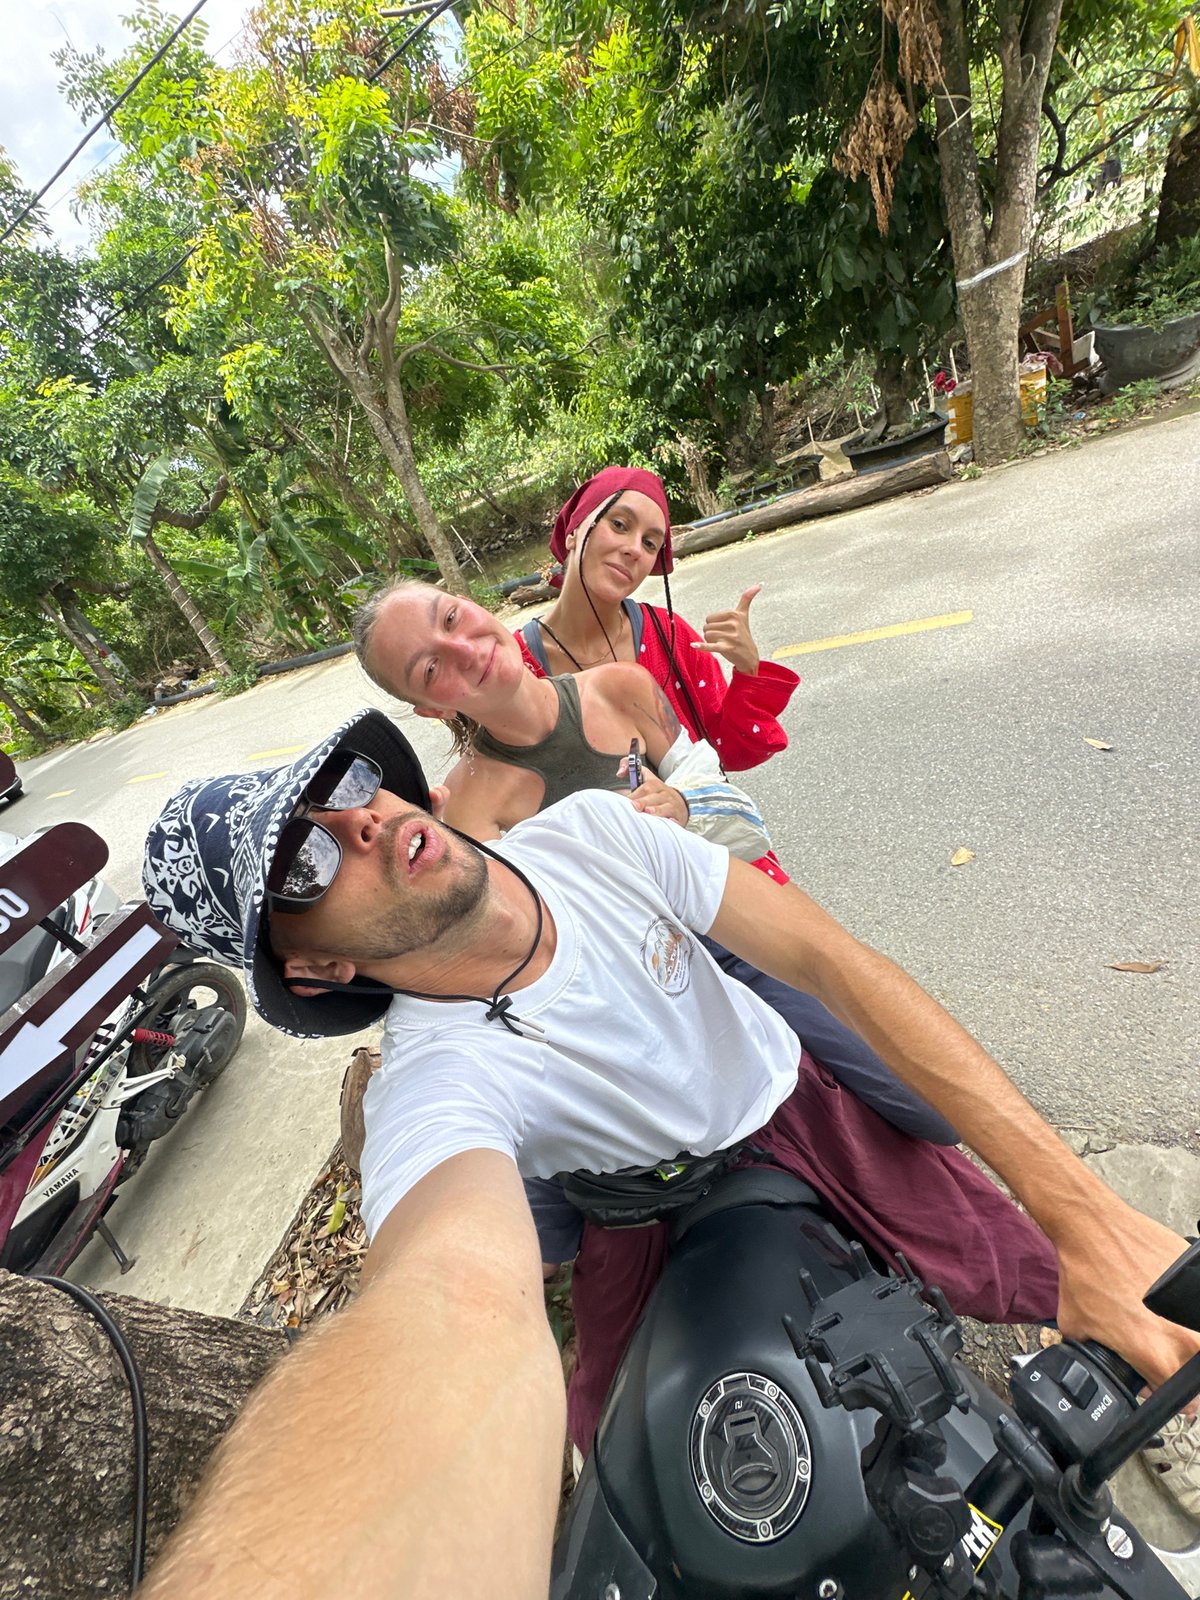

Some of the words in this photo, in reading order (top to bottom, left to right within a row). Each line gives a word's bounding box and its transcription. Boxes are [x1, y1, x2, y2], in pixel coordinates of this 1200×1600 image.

[0, 887, 30, 935] 0
[42, 1168, 79, 1198] YAMAHA
[1090, 1401, 1108, 1422] PASS
